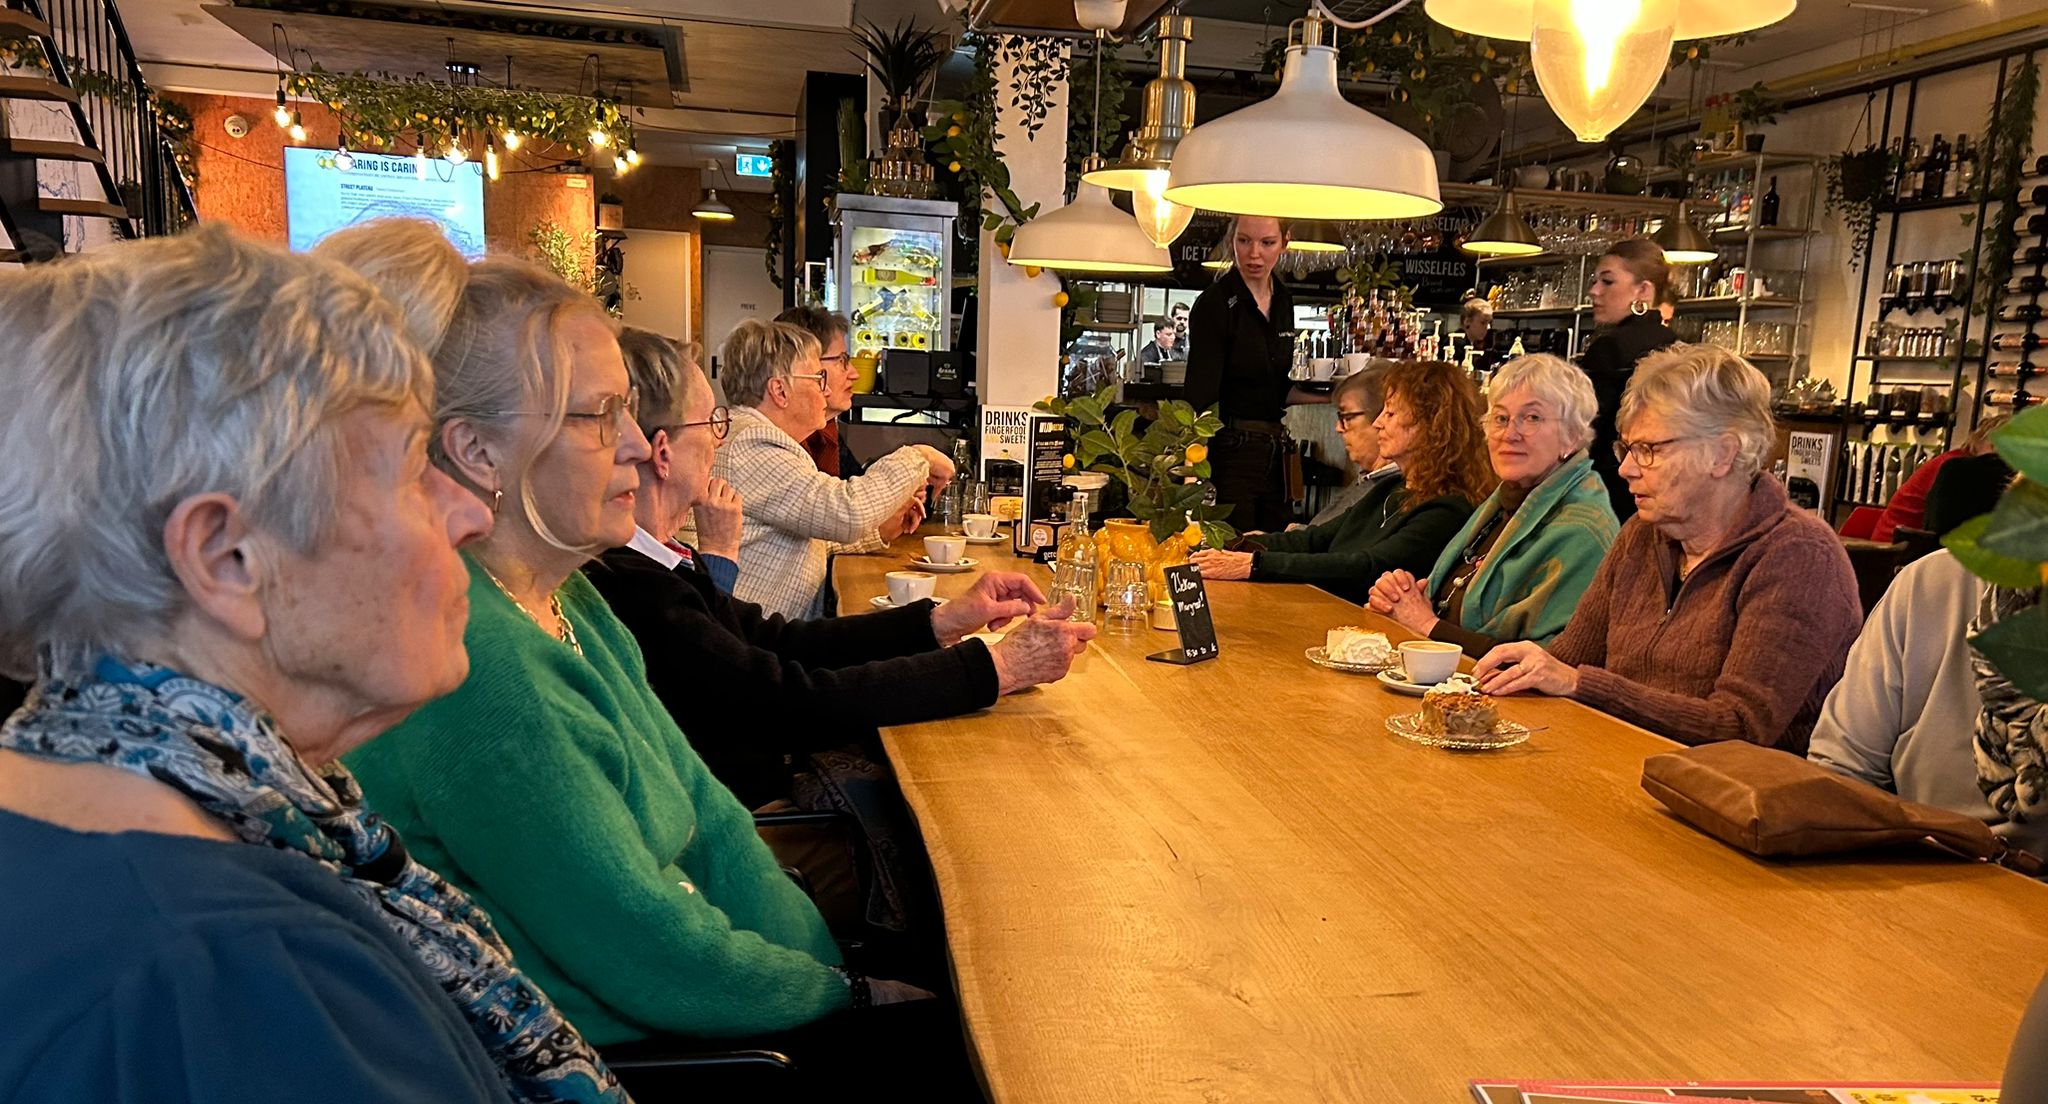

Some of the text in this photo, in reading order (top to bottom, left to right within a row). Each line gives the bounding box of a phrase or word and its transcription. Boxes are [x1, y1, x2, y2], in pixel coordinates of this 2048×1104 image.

[352, 159, 418, 174] ARING IS CARIN
[1181, 245, 1199, 261] ICE
[1405, 258, 1467, 277] WISSELFLES
[985, 410, 1029, 426] DRINKS
[1791, 435, 1824, 452] DRINKS
